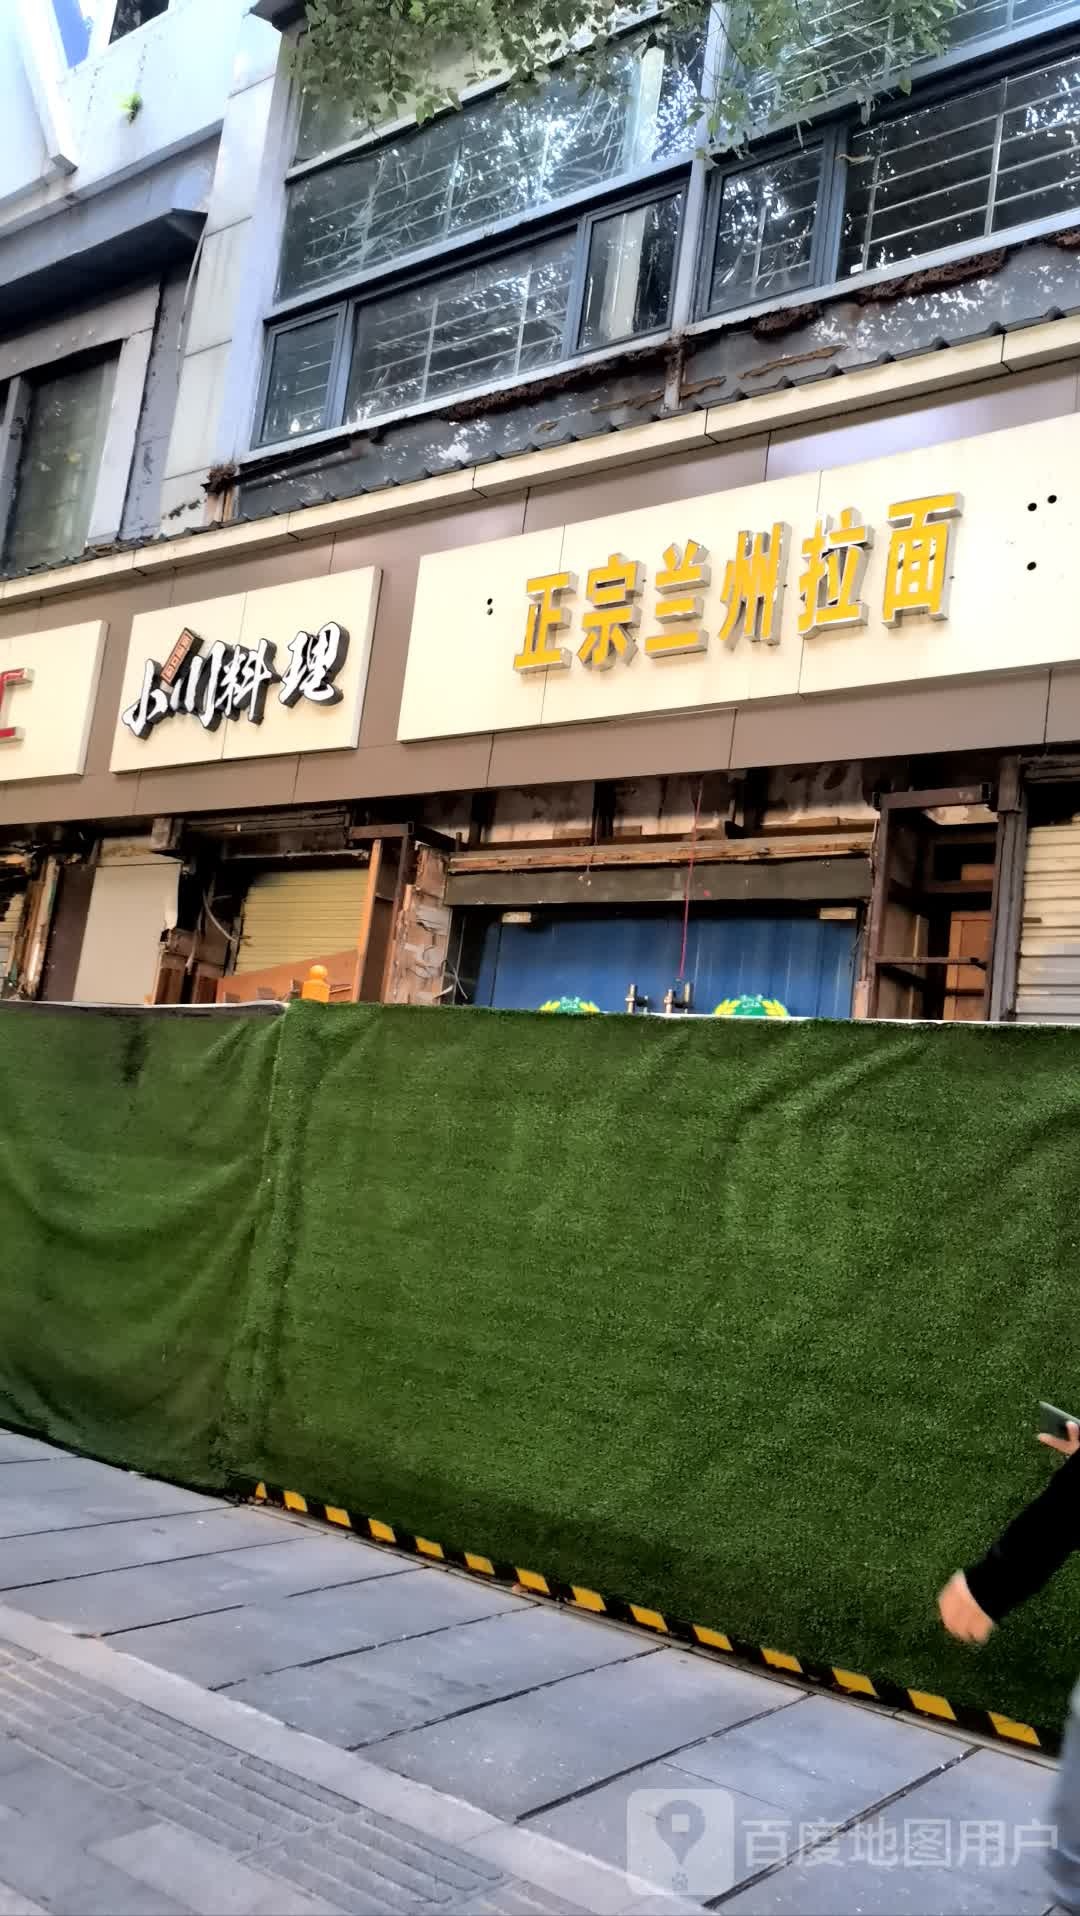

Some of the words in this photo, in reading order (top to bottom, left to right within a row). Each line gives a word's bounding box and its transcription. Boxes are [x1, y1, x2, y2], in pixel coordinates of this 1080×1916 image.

[514, 493, 962, 672] 正宗兰州拉面
